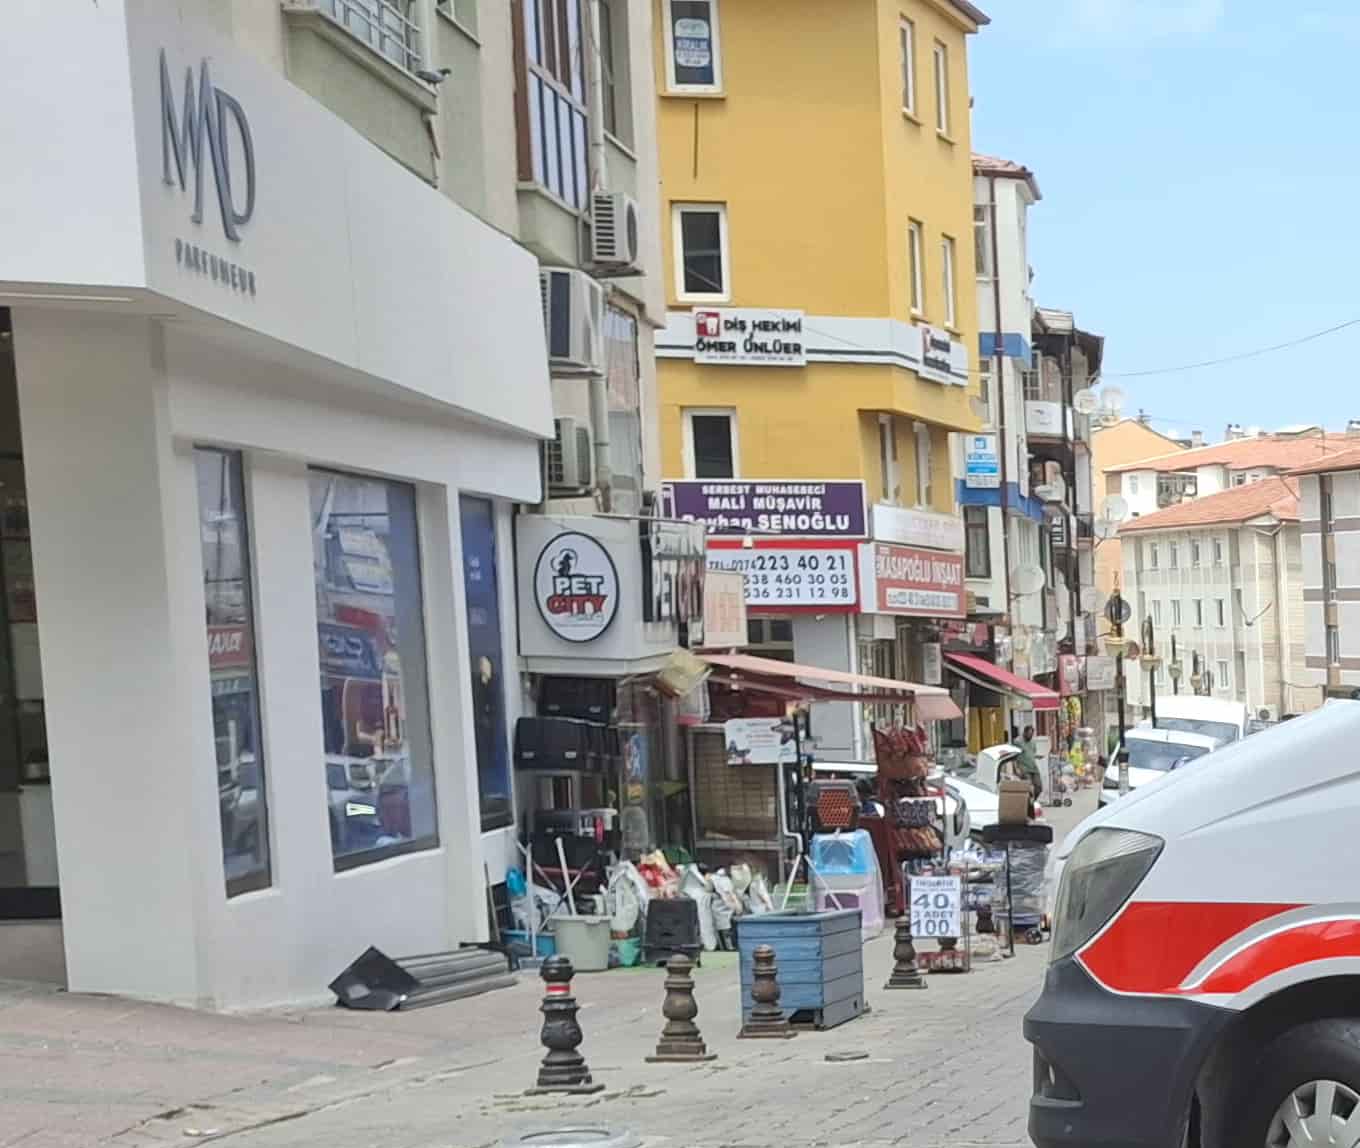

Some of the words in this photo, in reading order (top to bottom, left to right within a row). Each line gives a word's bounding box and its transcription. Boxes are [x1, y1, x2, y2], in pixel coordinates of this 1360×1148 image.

[724, 316, 746, 332] DİŞ
[751, 317, 802, 333] HEKİMİ
[696, 337, 737, 352] ÖMER
[744, 338, 802, 354] ÜNLÜER
[702, 485, 750, 495] SERBEST
[708, 495, 746, 510] MALİ
[753, 495, 822, 512] MÜŞAVİR
[756, 555, 790, 571] 223
[797, 555, 819, 571] 40
[826, 555, 847, 571] 21
[553, 575, 605, 596] PET
[775, 574, 802, 585] 460
[808, 574, 825, 585] 30
[830, 574, 848, 585] 05
[775, 588, 801, 598] 231
[810, 588, 825, 598] 12
[831, 588, 849, 598] 98
[913, 893, 950, 909] 40
[912, 919, 950, 935] 100
